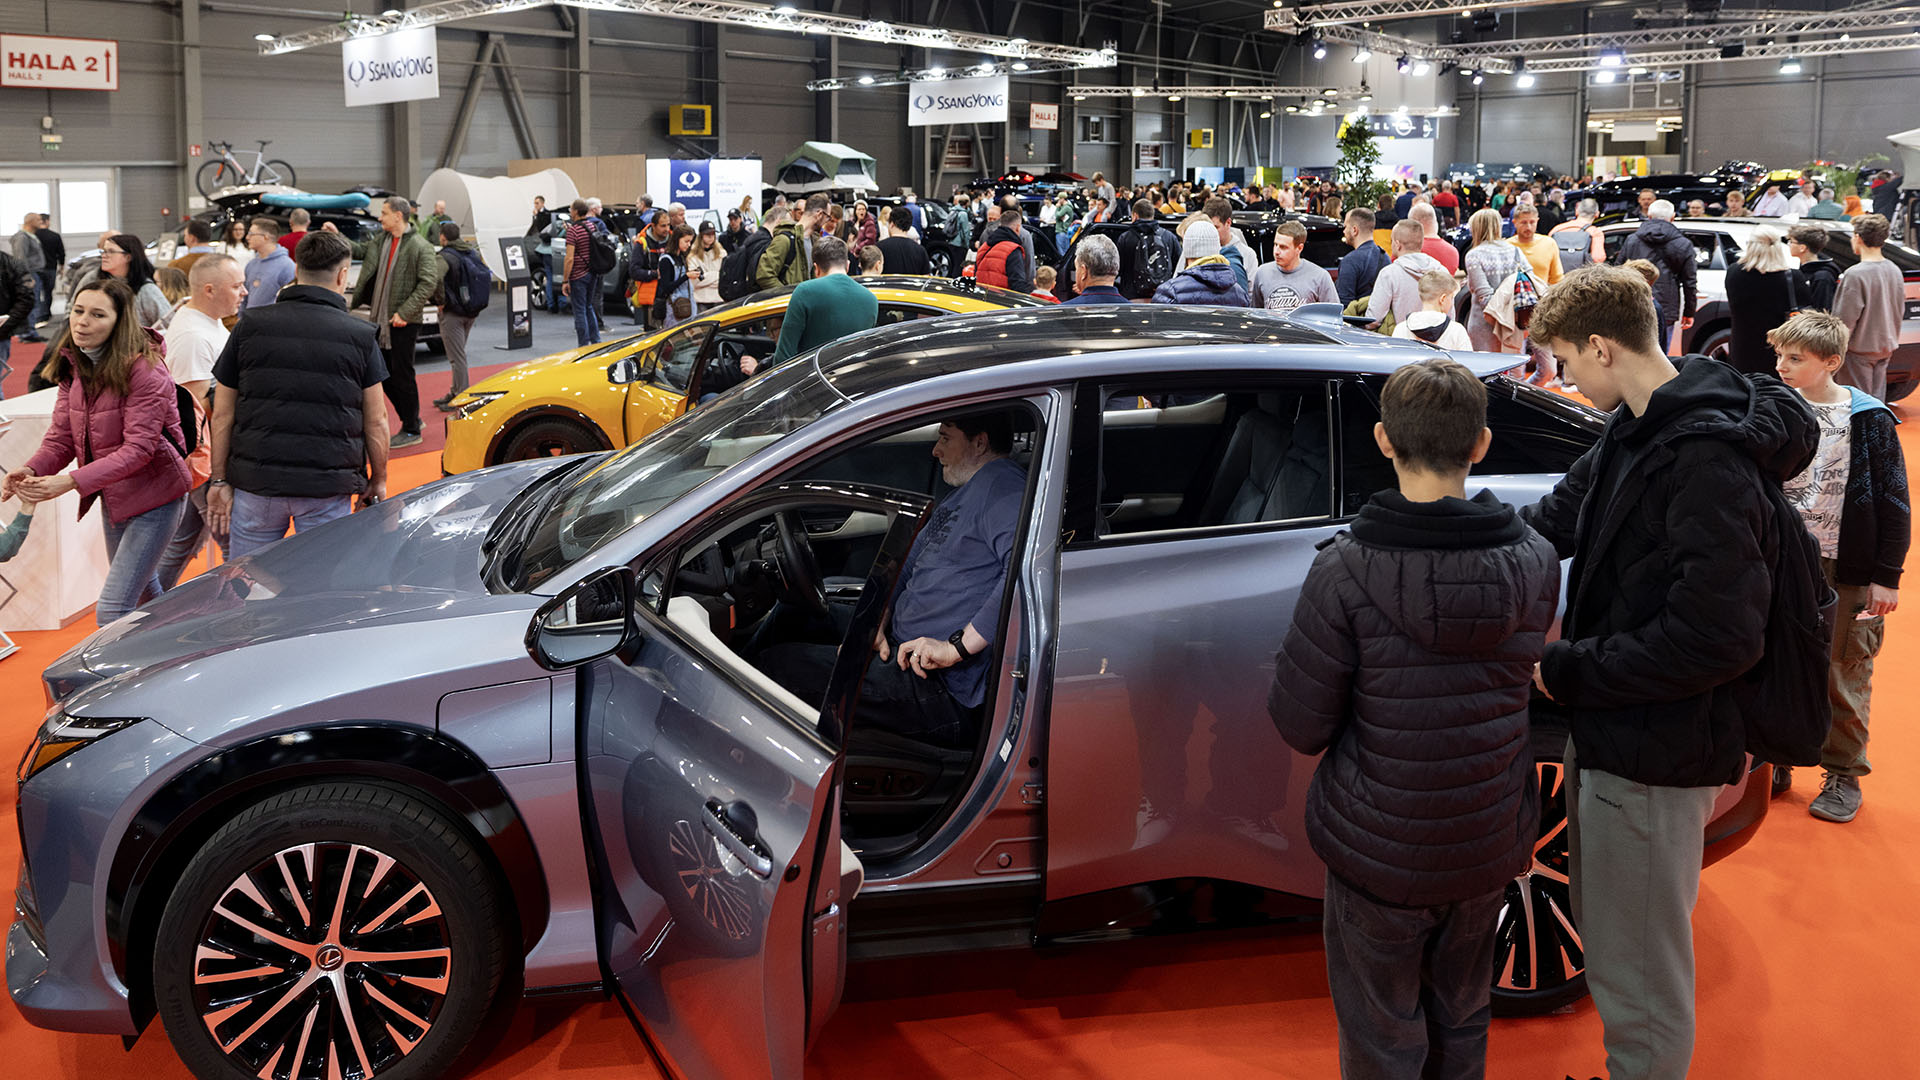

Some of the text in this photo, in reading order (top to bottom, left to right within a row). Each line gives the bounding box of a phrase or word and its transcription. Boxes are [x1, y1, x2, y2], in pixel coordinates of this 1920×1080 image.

[8, 52, 98, 72] HALA 2
[8, 71, 34, 80] HALL
[1035, 112, 1051, 121] HALA
